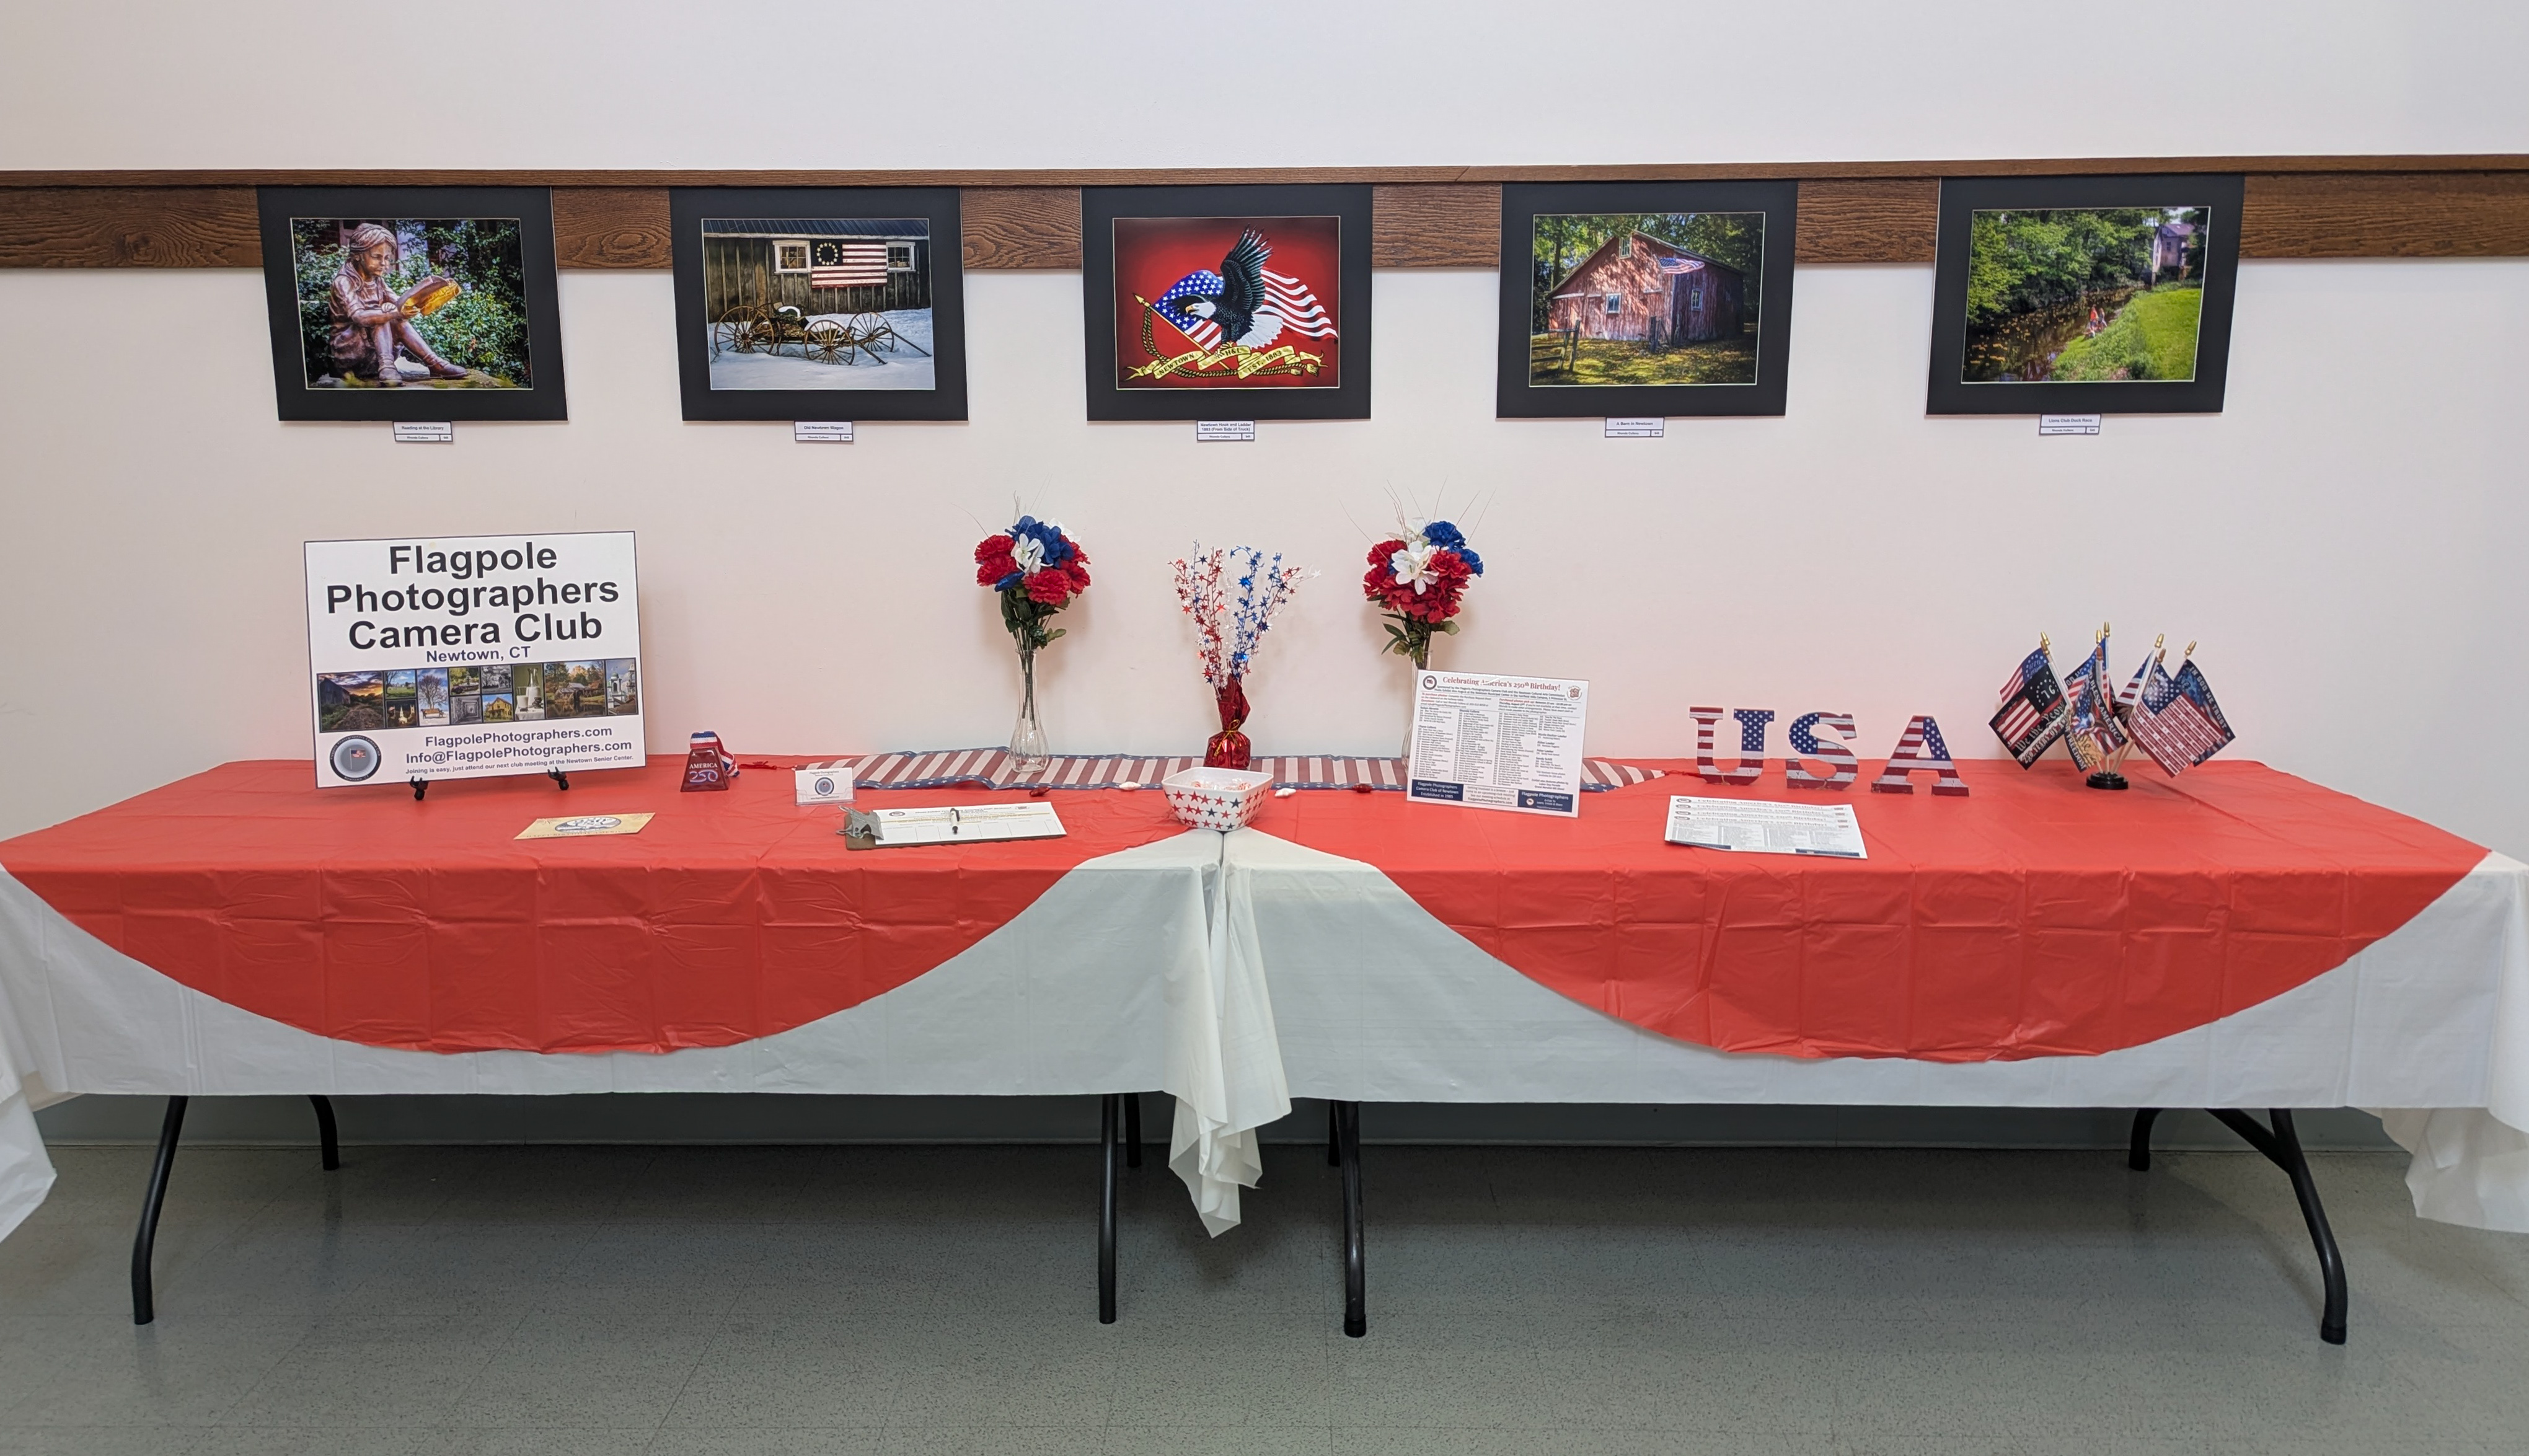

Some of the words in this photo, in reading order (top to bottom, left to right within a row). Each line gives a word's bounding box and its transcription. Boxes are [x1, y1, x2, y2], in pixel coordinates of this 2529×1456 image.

[1159, 353, 1194, 375] NEWTOWN
[1266, 350, 1282, 361] 1883
[390, 542, 557, 580] Flagpole
[327, 578, 619, 616] Photographers
[349, 621, 501, 649] Camera
[515, 611, 602, 642] Club
[426, 649, 504, 663] Newtown,
[510, 646, 531, 658] CT
[1443, 677, 1480, 686] Celebrating
[1530, 682, 1560, 691] Birthday!
[2041, 685, 2056, 699] 76
[2189, 666, 2198, 676] IN
[2197, 676, 2207, 691] GOD
[2206, 693, 2214, 703] WE
[2212, 704, 2228, 729] TRUST
[2090, 681, 2101, 705] BLESS
[2099, 707, 2124, 744] AMERICA
[426, 728, 612, 748] FlagpolePhotographers.com
[1689, 706, 1969, 796] USA
[2015, 737, 2031, 752] We
[2029, 725, 2043, 745] the
[2033, 734, 2050, 756] YEARS
[2049, 725, 2059, 739] OF
[2067, 733, 2086, 769] FREEDOM
[407, 742, 632, 764] Info@FlagpolePhotographers.com
[689, 769, 718, 783] 250
